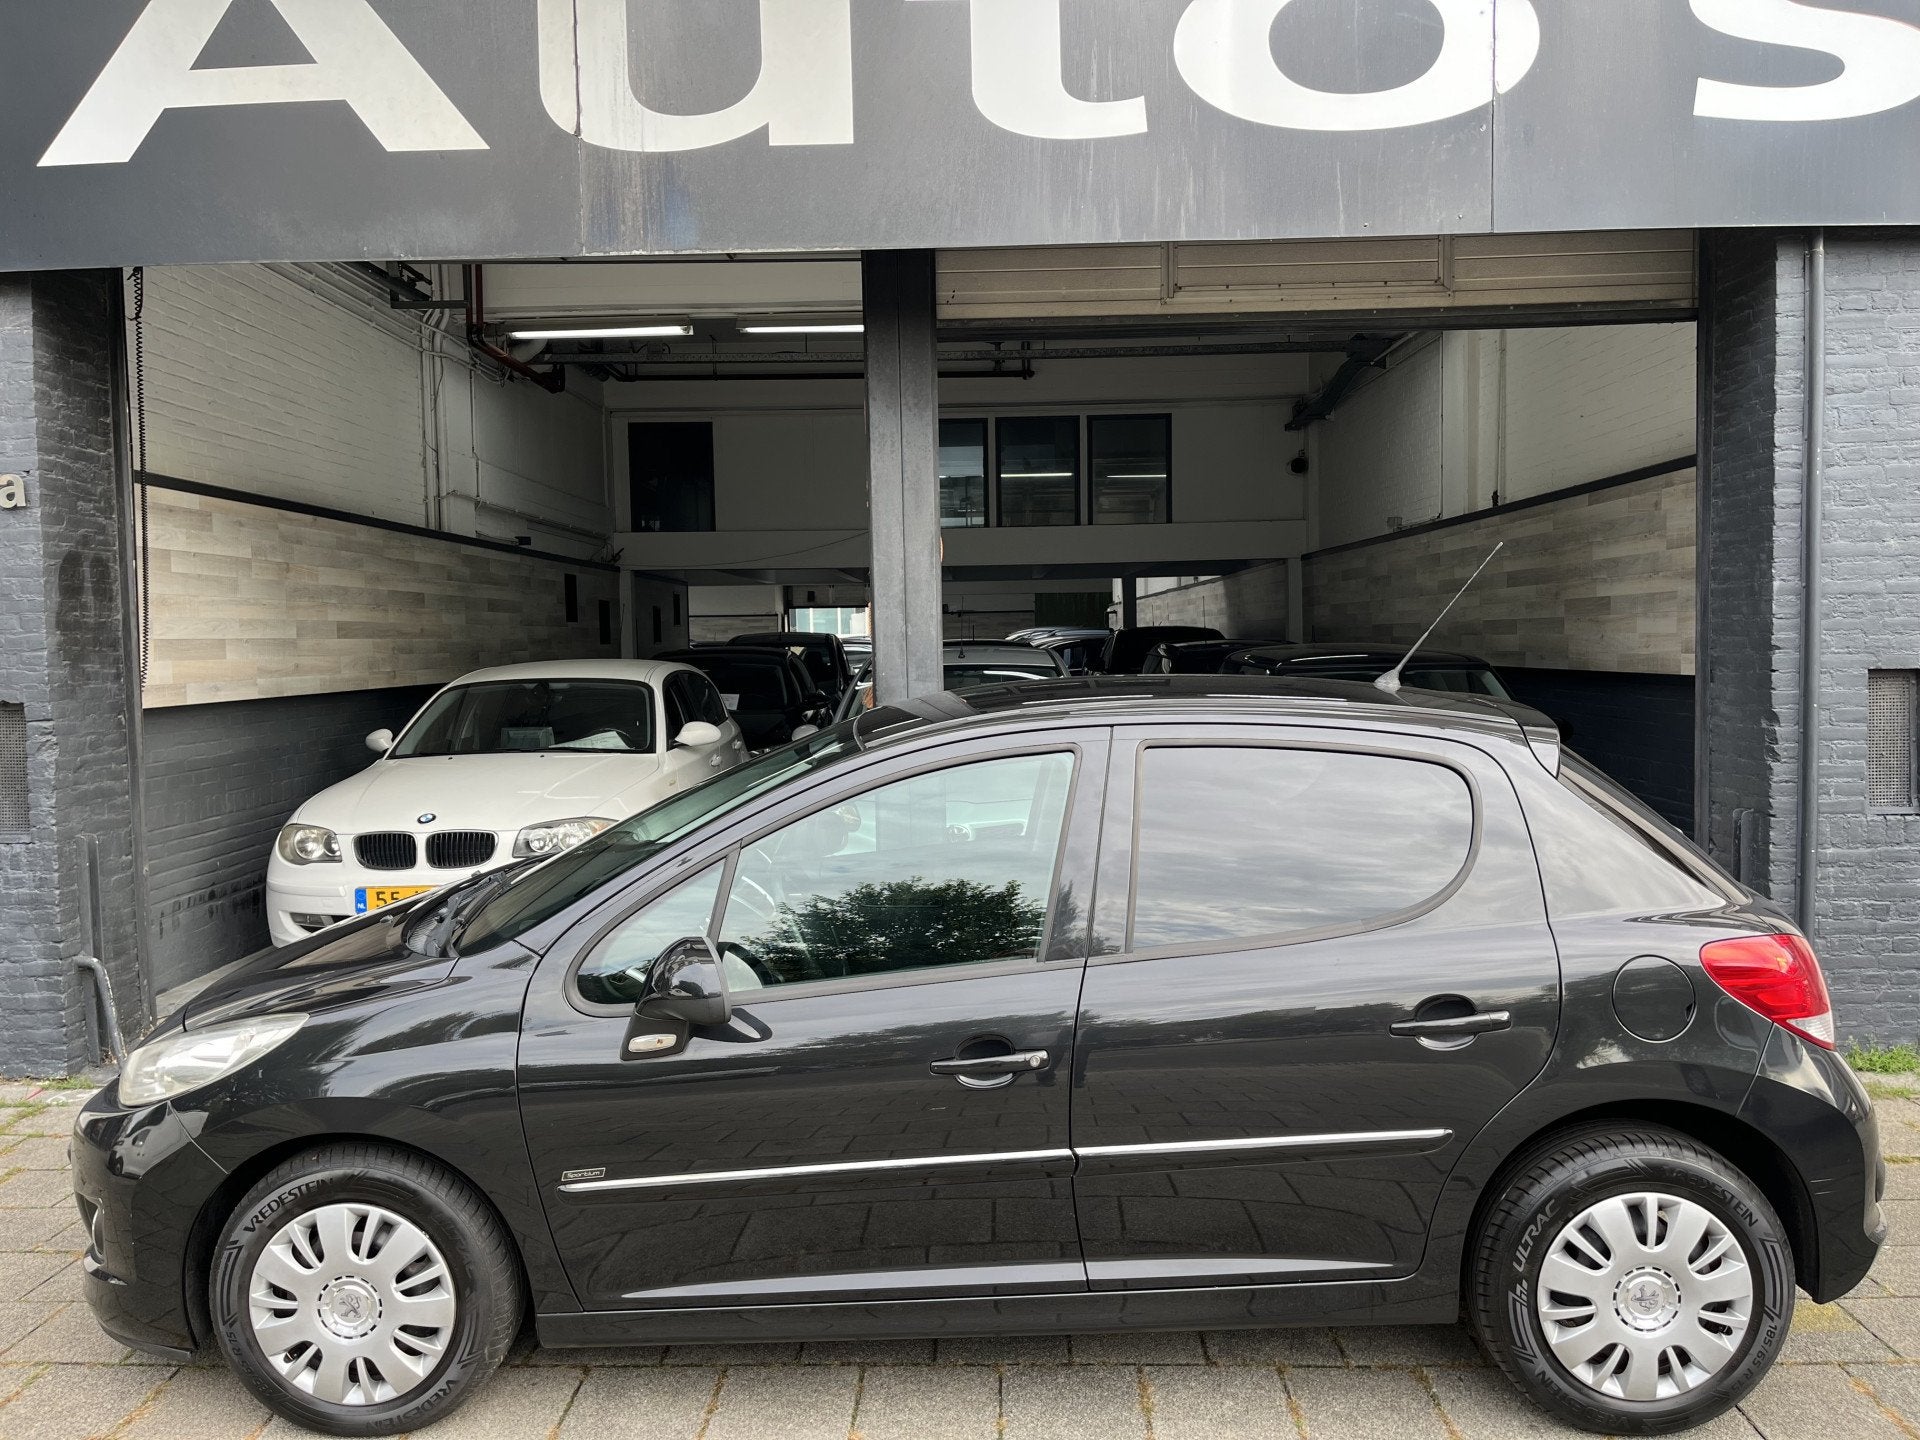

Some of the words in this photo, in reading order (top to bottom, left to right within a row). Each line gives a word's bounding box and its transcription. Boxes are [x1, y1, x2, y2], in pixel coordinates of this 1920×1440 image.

[0, 474, 26, 508] a
[567, 1170, 600, 1179] Sportium
[244, 1177, 334, 1233] VREDESTEIN
[1513, 1199, 1560, 1272] ULTRAC
[1753, 1325, 1778, 1368] 185/65
[1732, 1380, 1745, 1393] 15
[1743, 1368, 1754, 1380] R
[366, 1380, 457, 1430] VREDESTEIN
